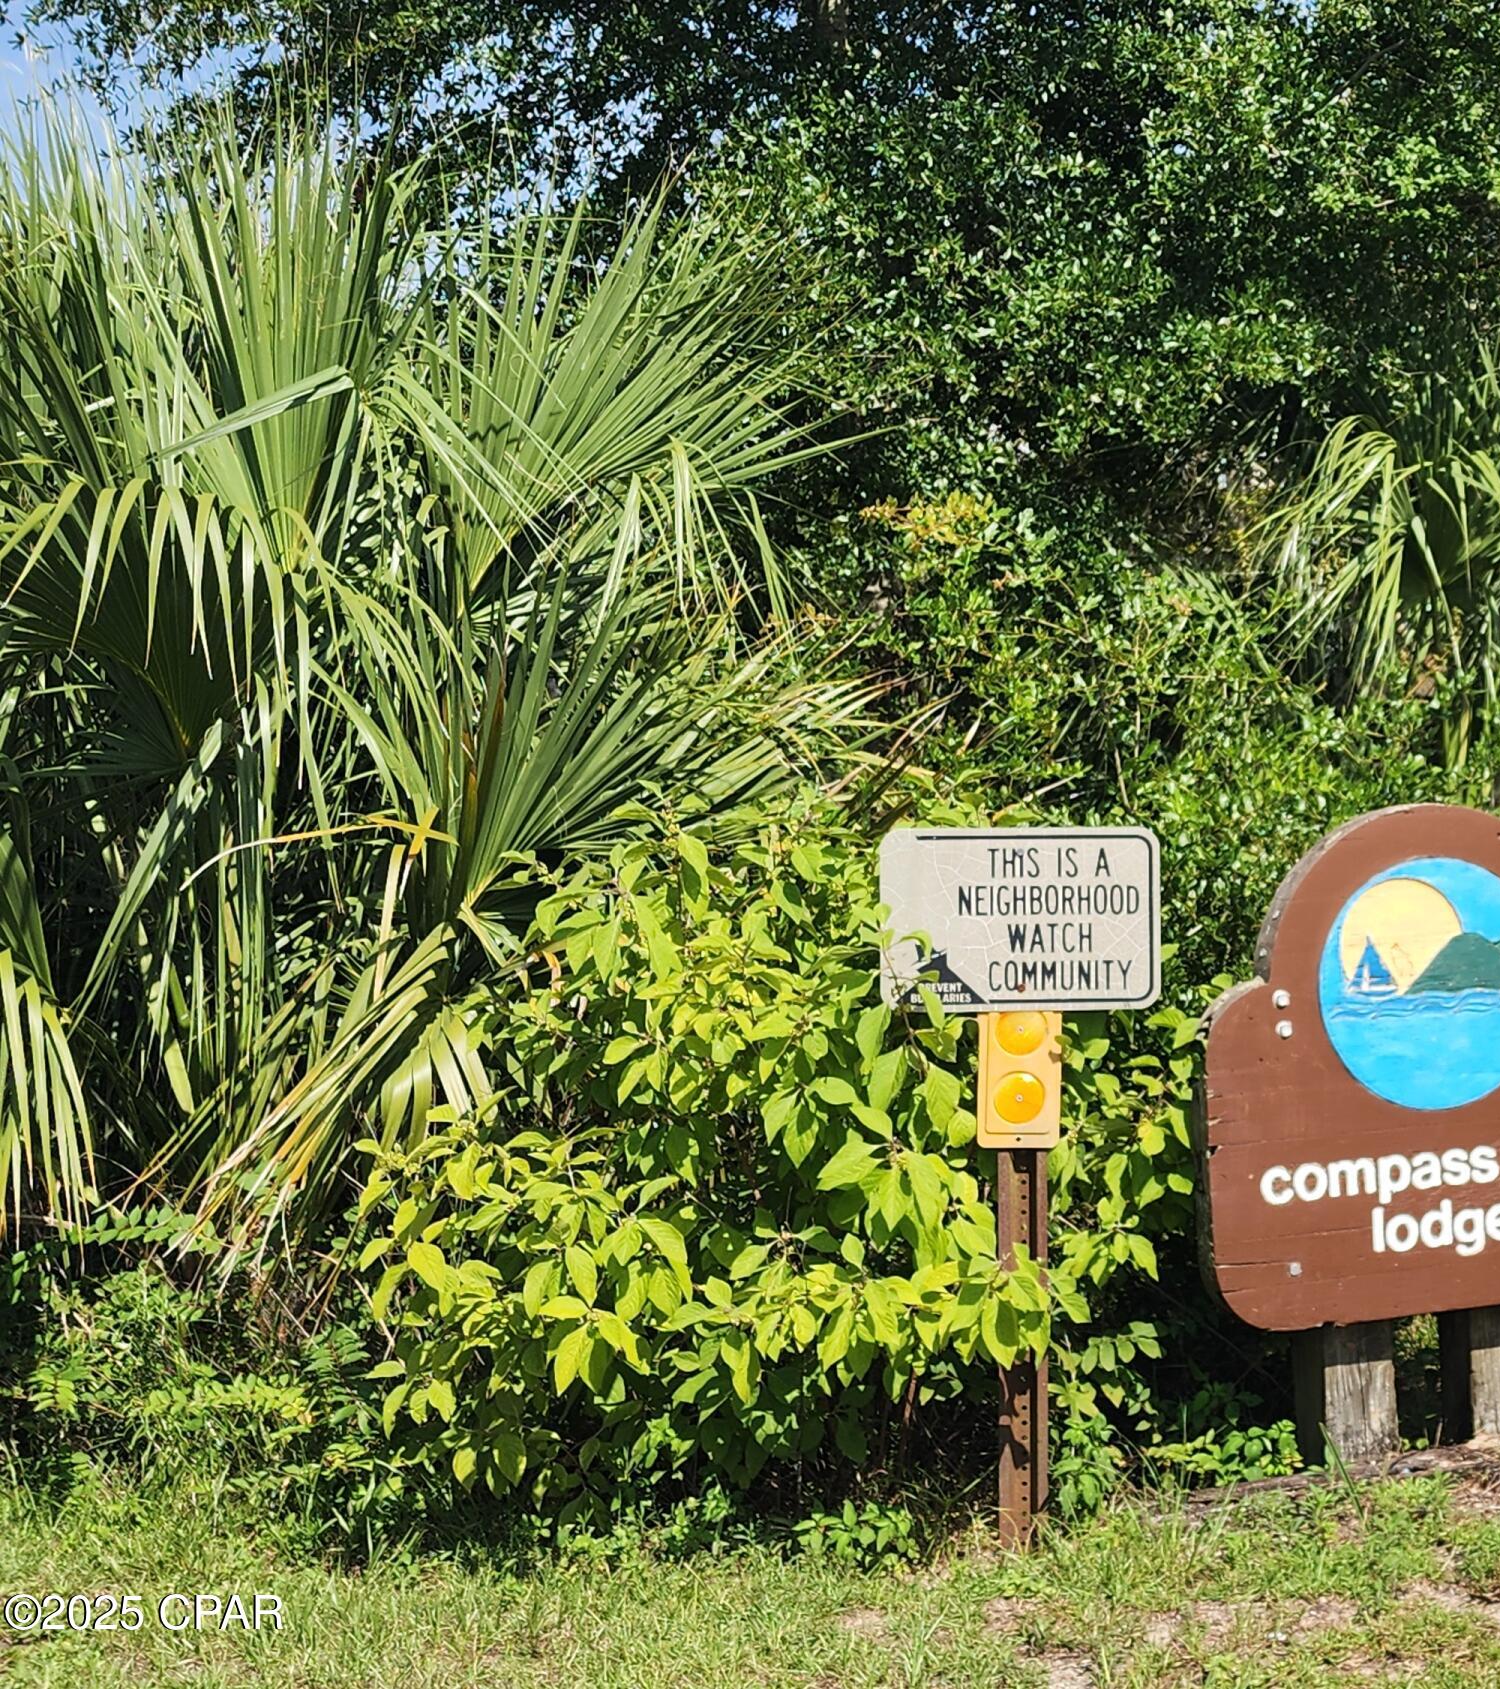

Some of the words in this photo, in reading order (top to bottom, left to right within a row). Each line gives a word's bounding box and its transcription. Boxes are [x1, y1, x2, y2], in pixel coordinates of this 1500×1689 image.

[987, 847, 1040, 878] THIS
[1057, 847, 1079, 877] IS
[1095, 847, 1111, 877] A
[958, 885, 1140, 916] NEIGHBORHOOD
[1007, 923, 1093, 953] WATCH
[988, 959, 1133, 992] COMMUNITY
[1259, 1145, 1500, 1205] compass
